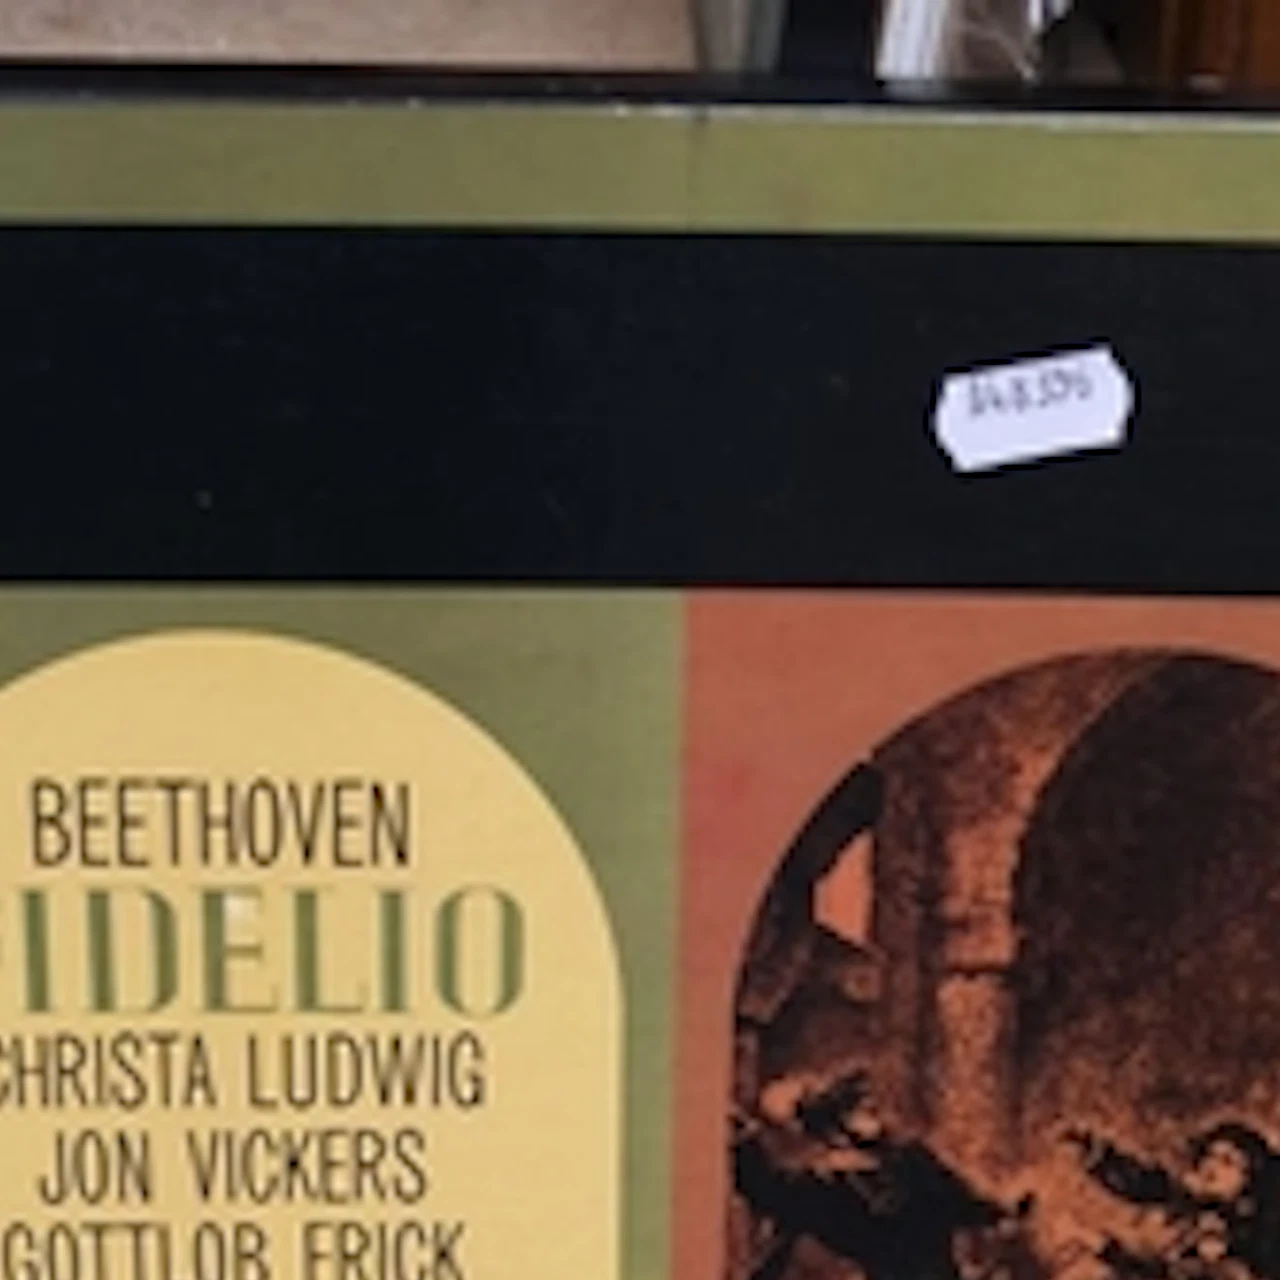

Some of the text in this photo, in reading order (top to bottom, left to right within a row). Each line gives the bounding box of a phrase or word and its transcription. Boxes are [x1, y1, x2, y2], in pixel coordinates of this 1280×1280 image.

[29, 775, 411, 870] BEETHOVEN
[246, 1028, 486, 1114] LUDWIG
[36, 1125, 429, 1208] JON VICKERS
